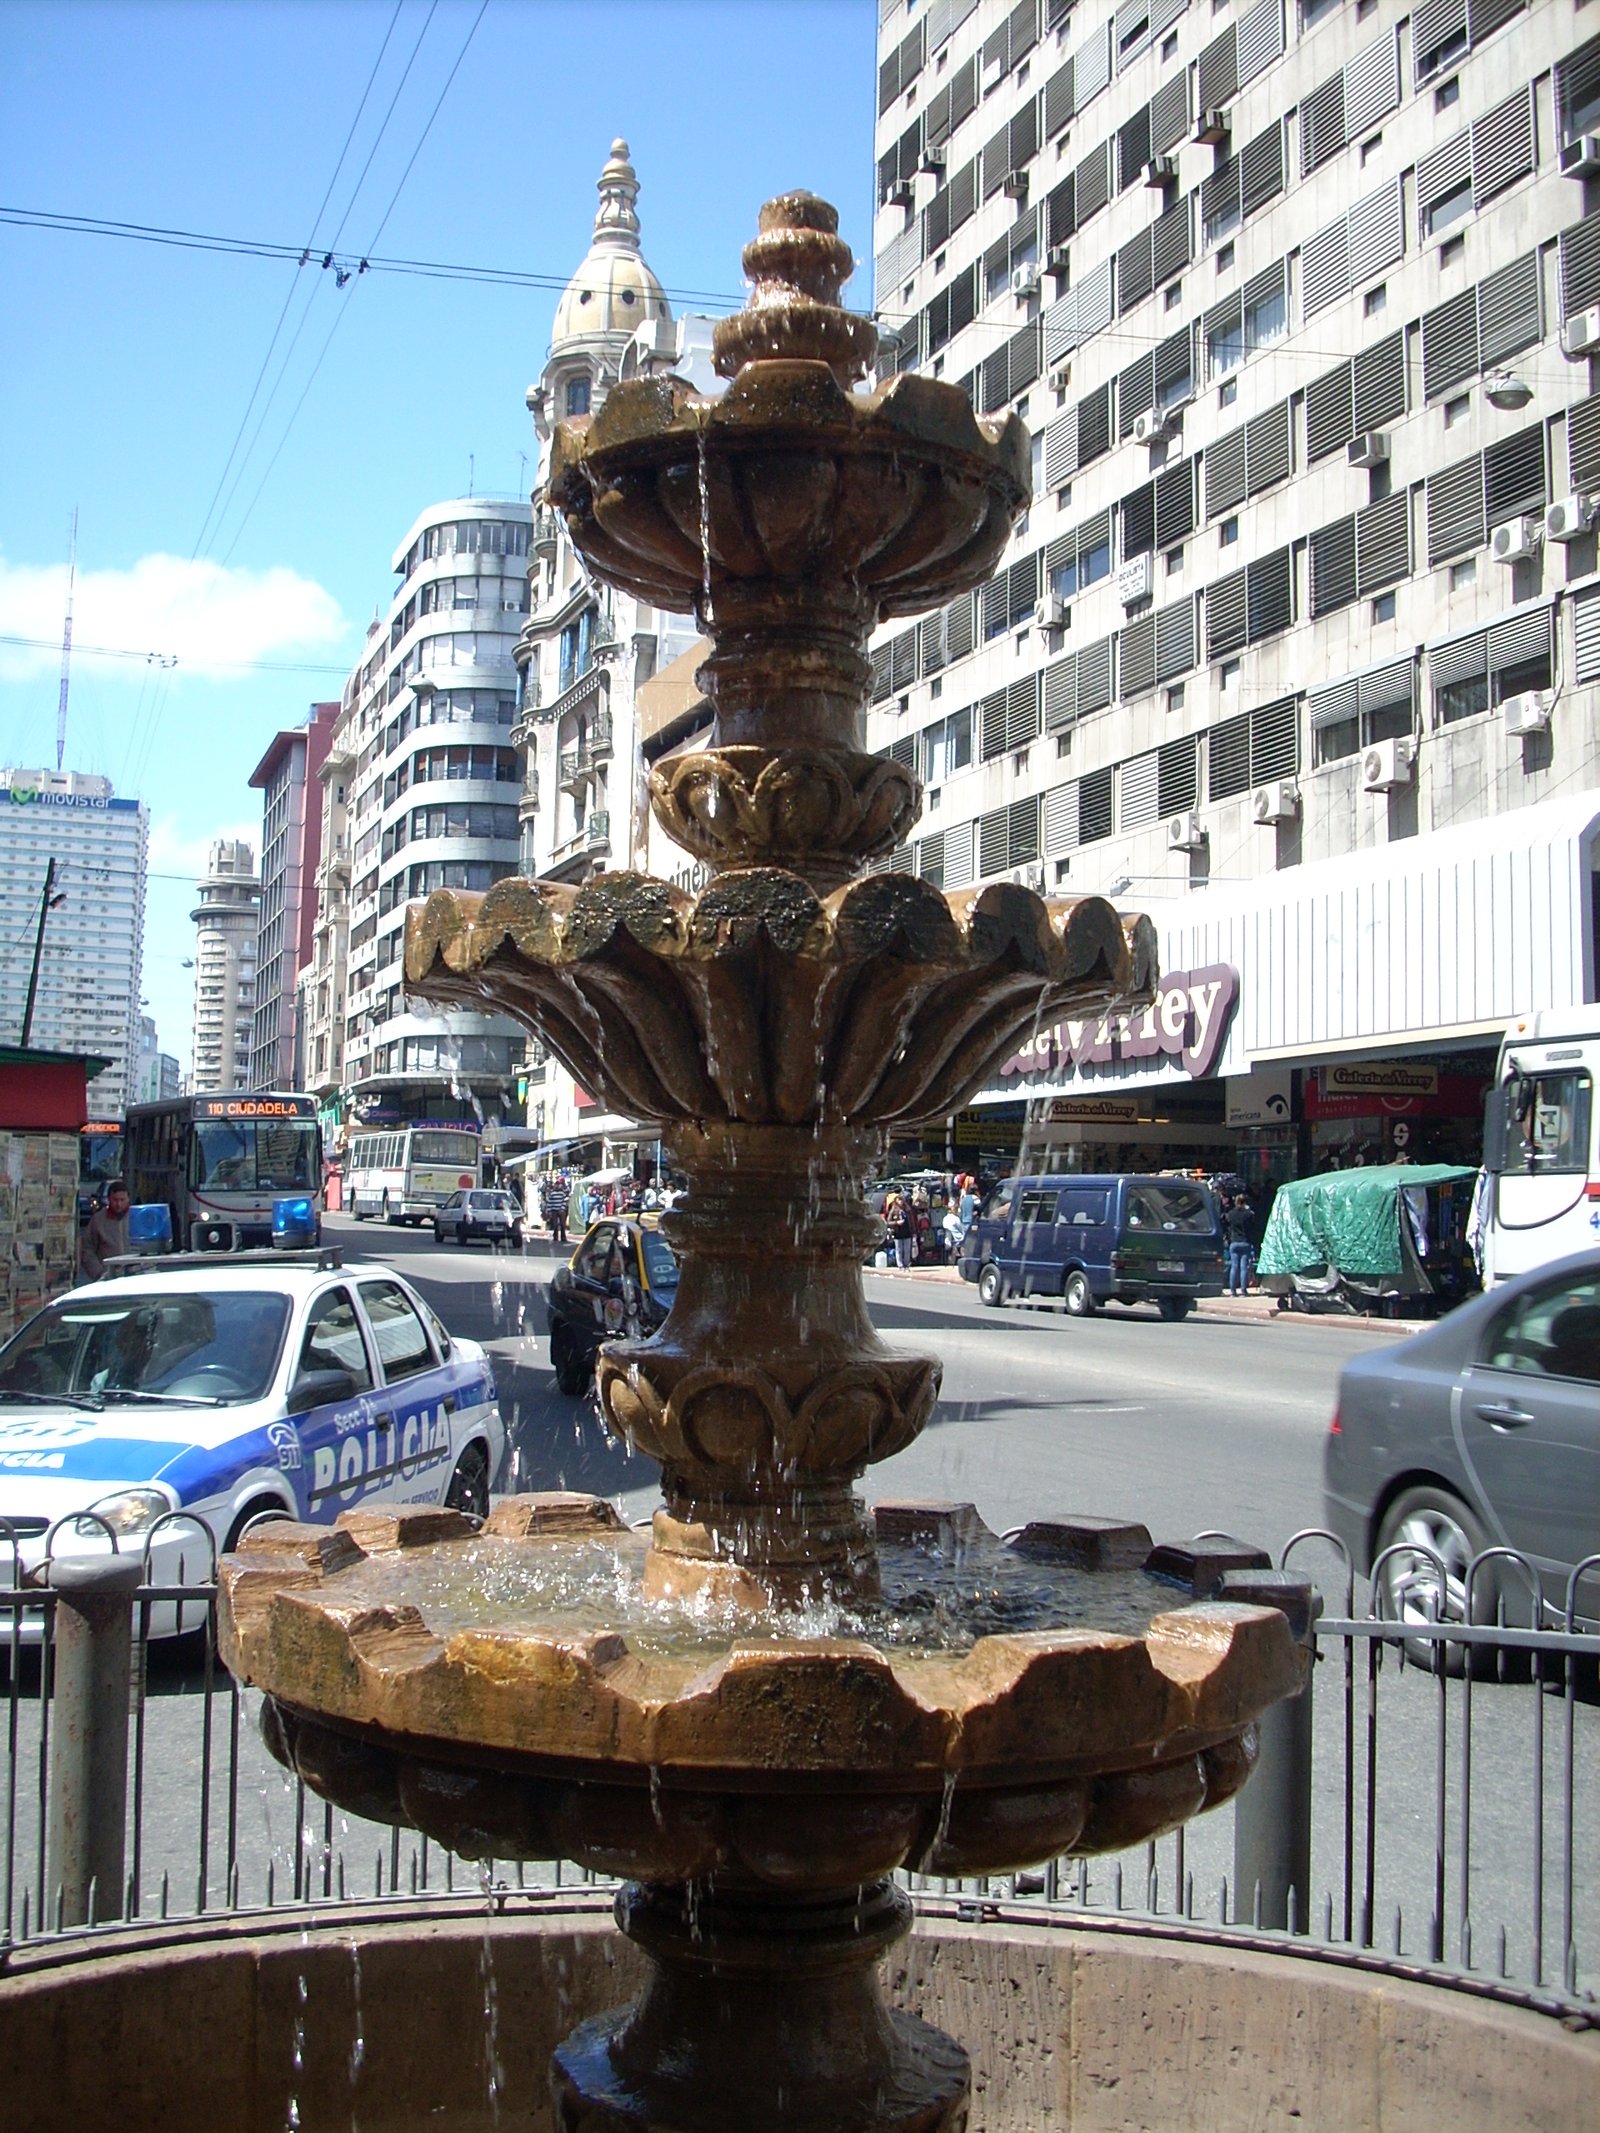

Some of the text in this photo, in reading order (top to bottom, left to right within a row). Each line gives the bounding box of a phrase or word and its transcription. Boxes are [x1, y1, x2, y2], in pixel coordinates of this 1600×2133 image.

[42, 792, 110, 808] movistar
[1333, 1067, 1380, 1084] Galeria
[1392, 1069, 1434, 1089] Virrey
[208, 1102, 298, 1115] 110 CIUDADELA
[1051, 1101, 1091, 1114] Galeria
[1100, 1102, 1134, 1118] Virrey
[334, 1410, 364, 1434] Secc.
[310, 1400, 452, 1514] POLICIA
